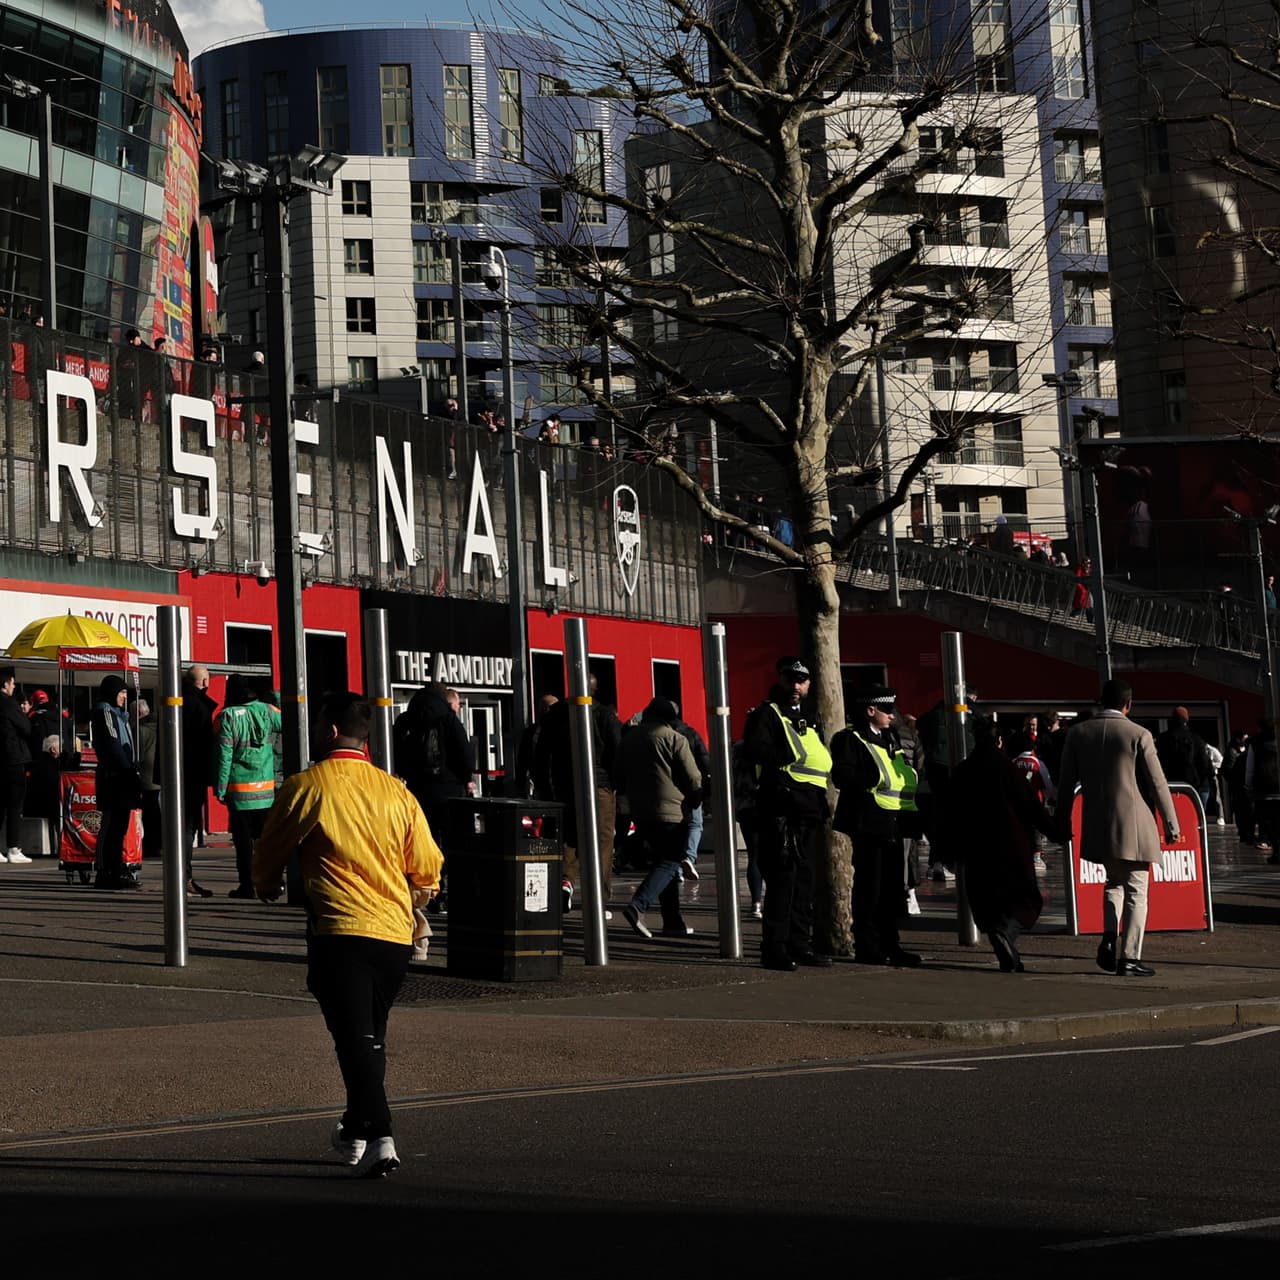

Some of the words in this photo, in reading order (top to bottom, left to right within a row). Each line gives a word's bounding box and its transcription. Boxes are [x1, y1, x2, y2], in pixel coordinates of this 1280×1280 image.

[117, 613, 159, 647] OFFIC
[396, 650, 432, 682] THE
[435, 652, 513, 687] ARMOURY
[72, 792, 97, 805] Arse
